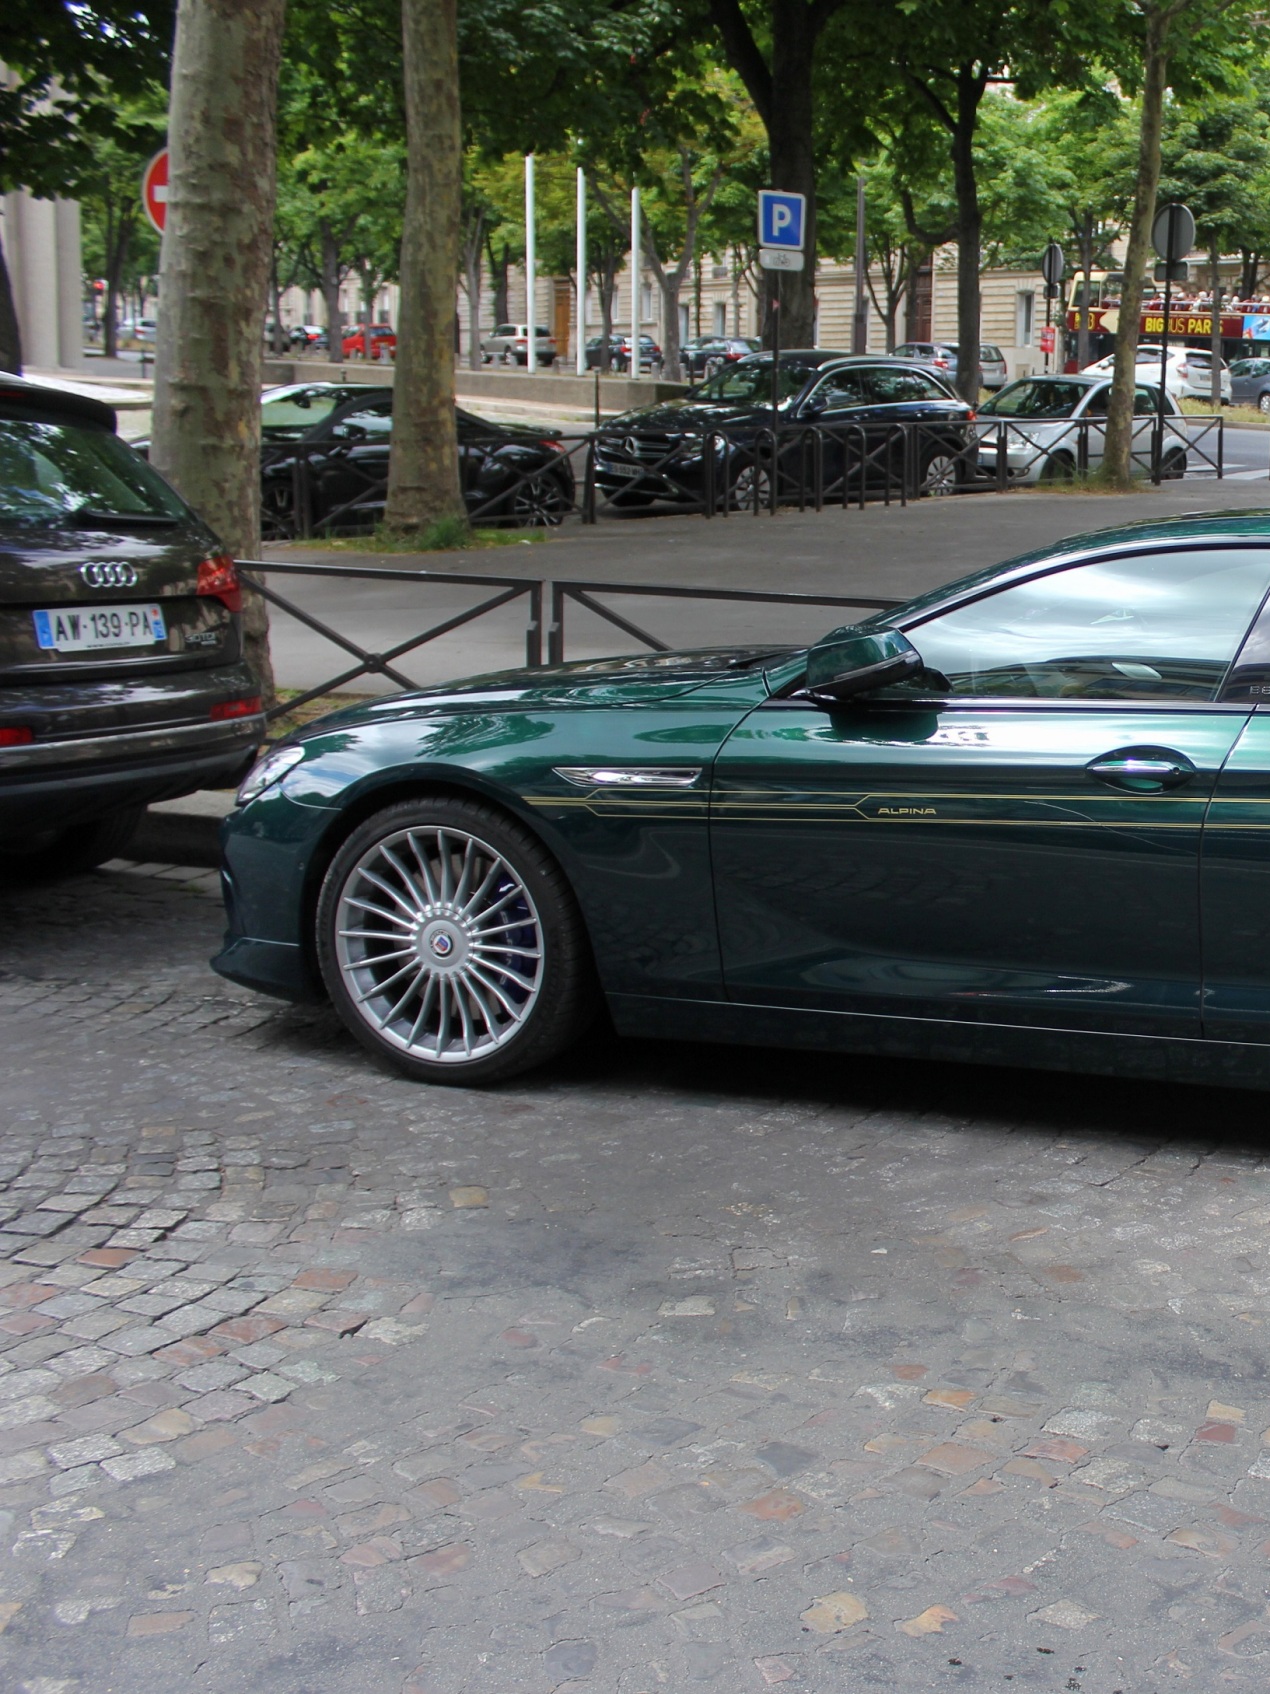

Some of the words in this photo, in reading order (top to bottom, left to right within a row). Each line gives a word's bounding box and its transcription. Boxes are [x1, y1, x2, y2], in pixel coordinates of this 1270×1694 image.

[772, 203, 792, 237] P
[1145, 317, 1165, 333] BIG
[1167, 318, 1186, 334] US
[877, 807, 937, 815] ALPINA
